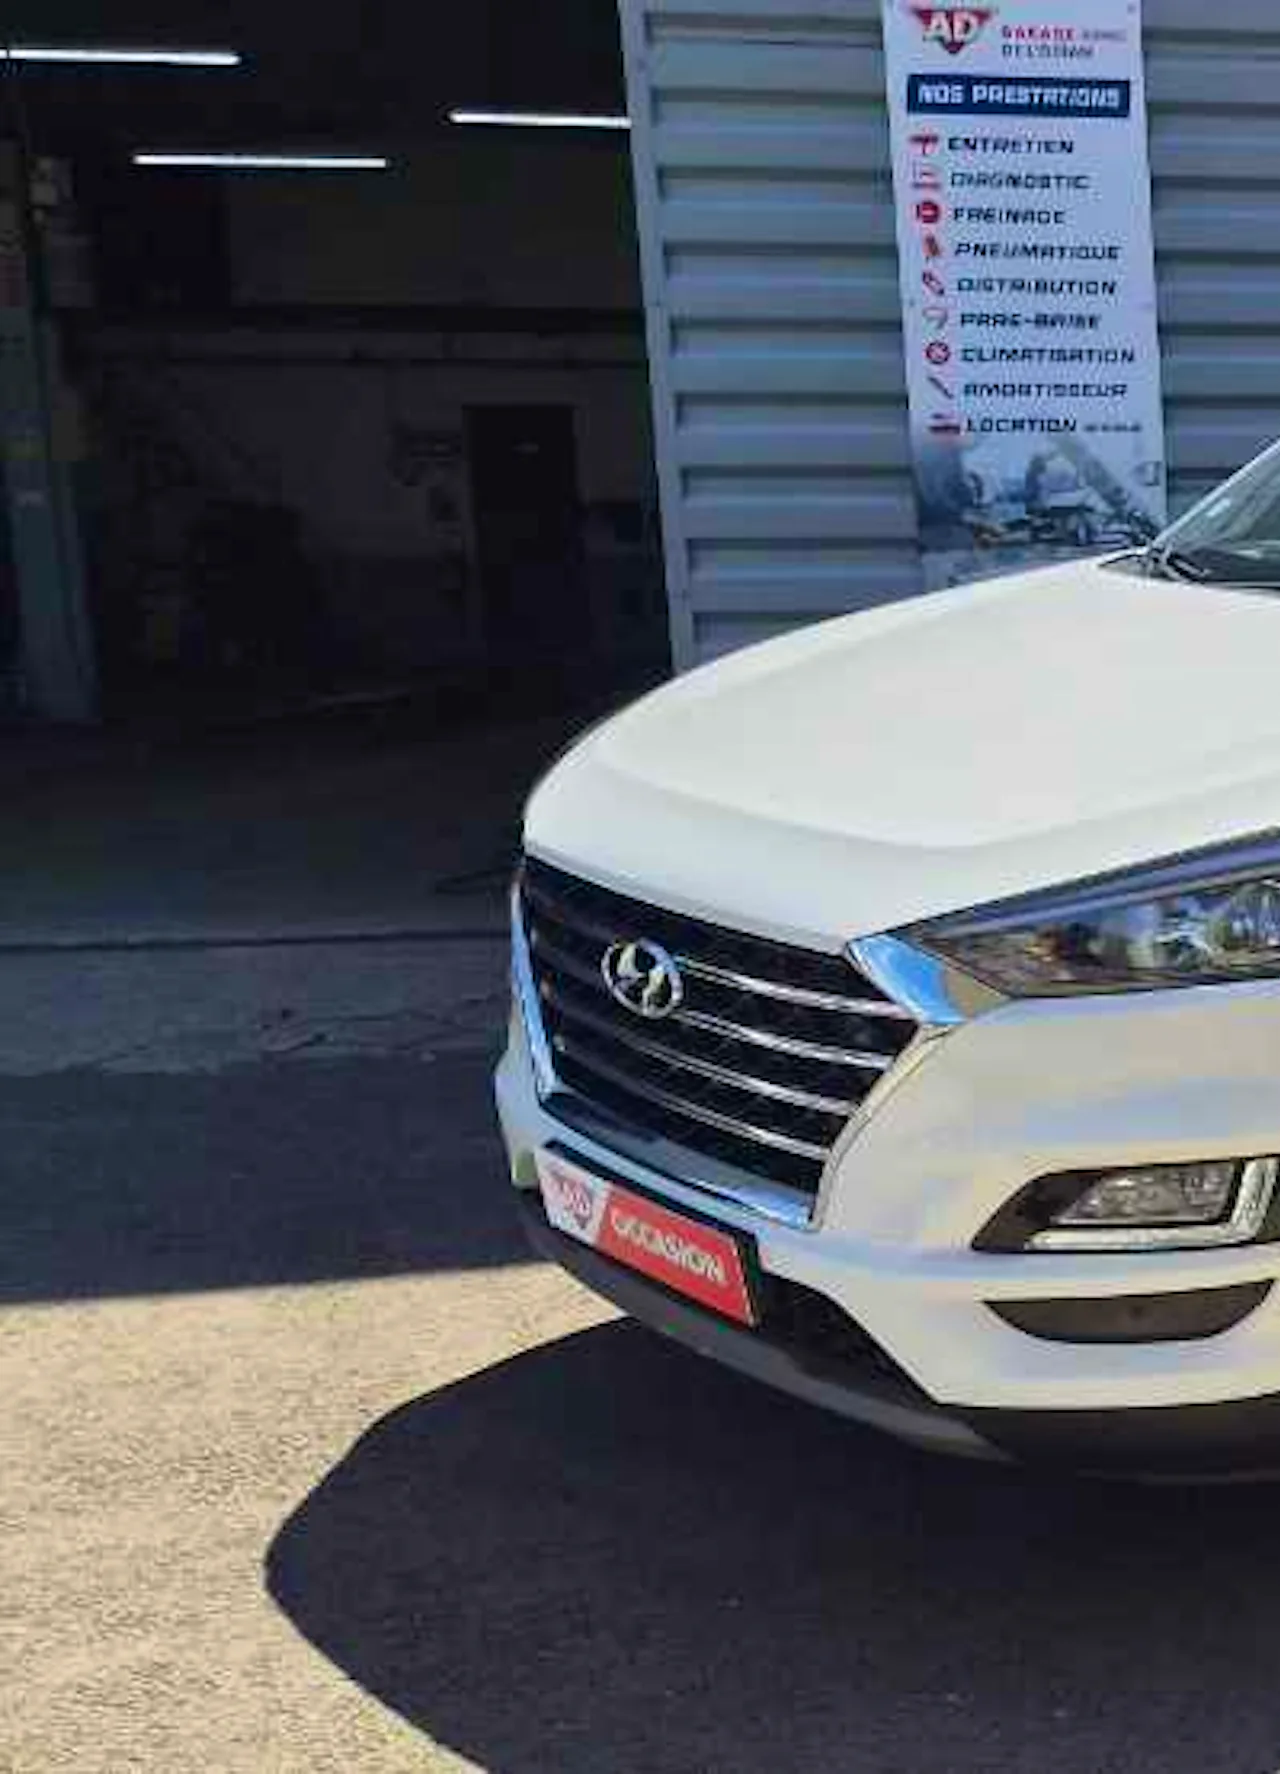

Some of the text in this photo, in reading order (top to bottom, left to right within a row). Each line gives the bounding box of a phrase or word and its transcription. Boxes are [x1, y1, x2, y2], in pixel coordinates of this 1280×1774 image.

[917, 84, 1120, 108] NOS PRESTATIONS
[947, 137, 1074, 154] ENTRETIEN
[951, 173, 1090, 190] DIAGNOSTIC
[954, 207, 1065, 224] FREINAGE
[955, 243, 1121, 261] PNEUMATIQUE
[957, 277, 1117, 296] DISTRIBUTION
[960, 313, 1101, 329] PARE-BRISE
[961, 348, 1135, 364] CLIMATISATION
[963, 383, 1128, 399] AMORTISSEUR
[967, 418, 1077, 434] LOCATION
[609, 1206, 726, 1283] OCCASION
